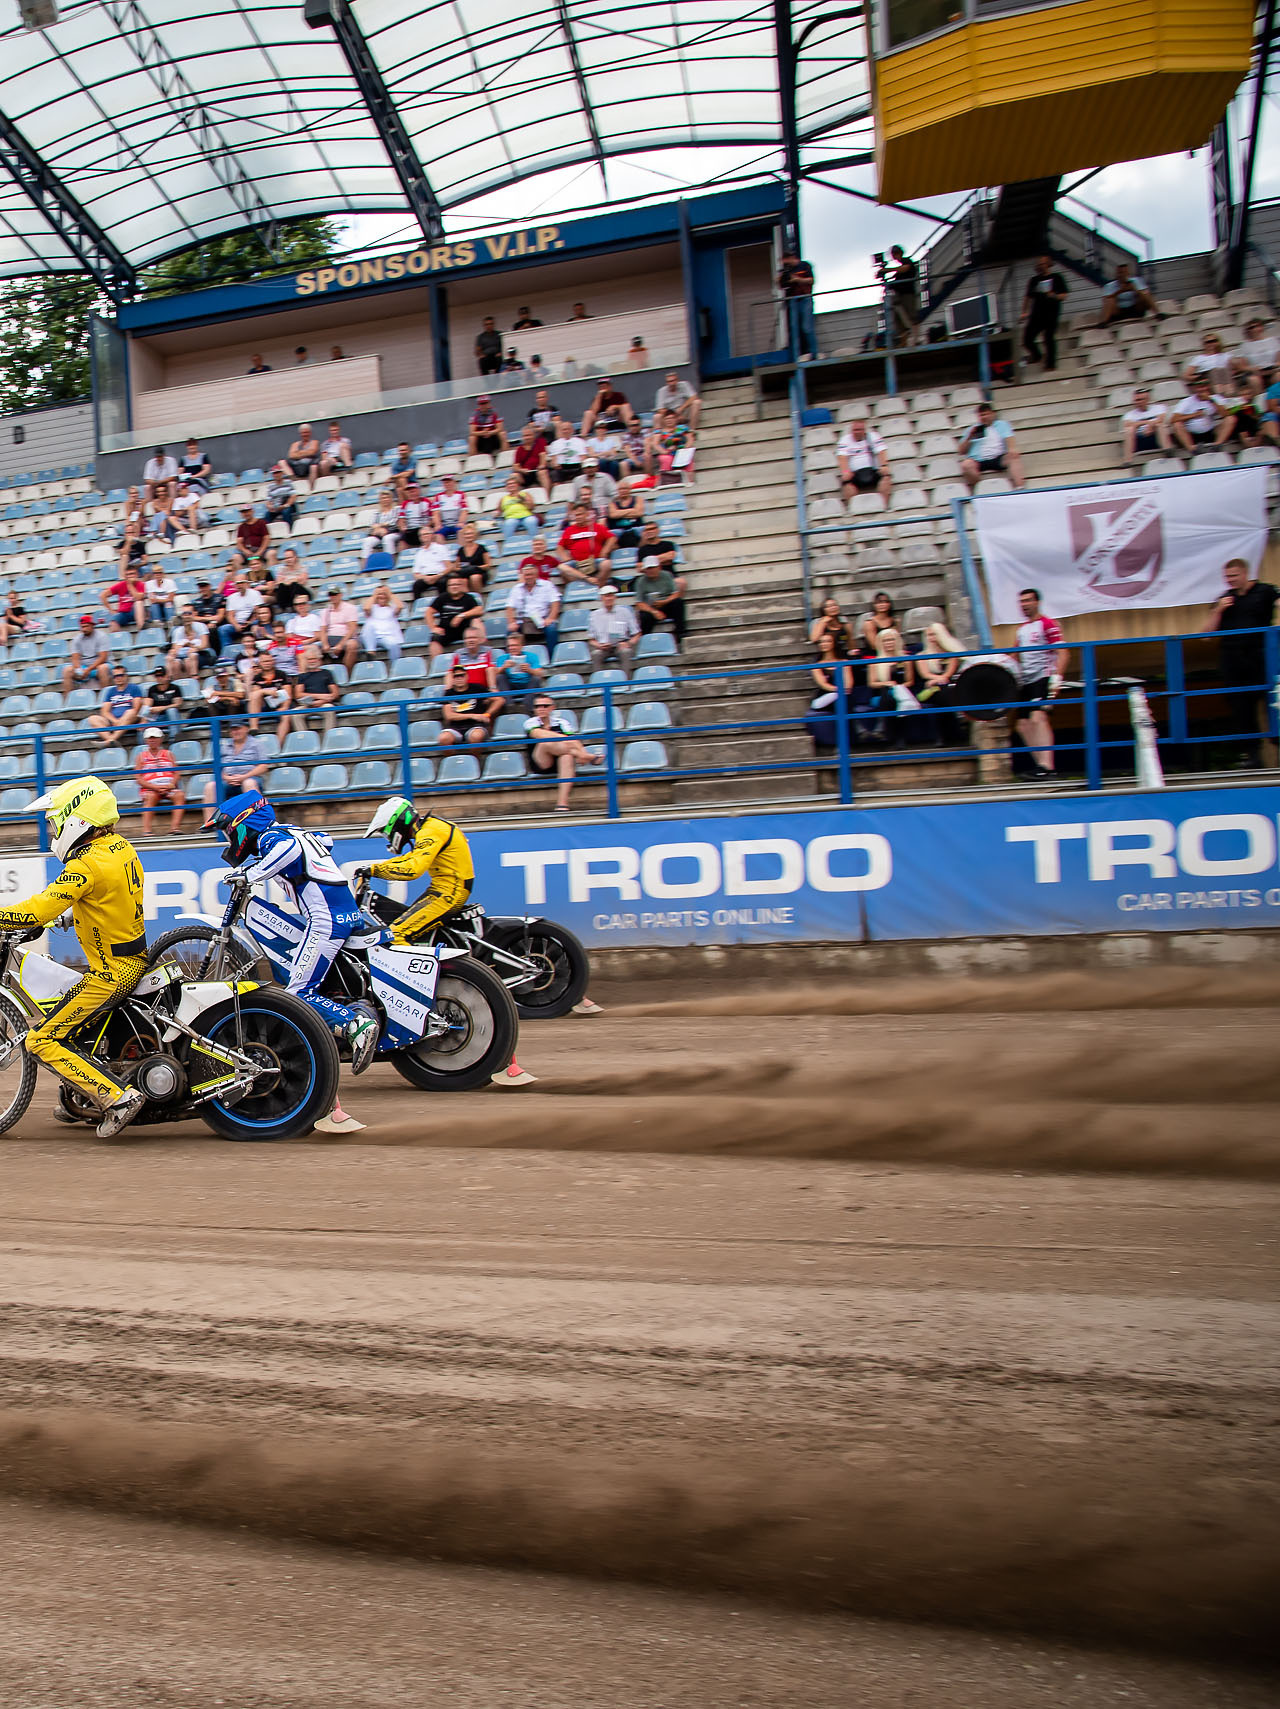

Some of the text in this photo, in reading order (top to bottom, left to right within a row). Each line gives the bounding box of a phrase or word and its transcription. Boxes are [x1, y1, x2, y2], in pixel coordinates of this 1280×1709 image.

[295, 227, 565, 295] SPONSORS V.I.P.
[1005, 813, 1280, 884] TRO
[59, 874, 81, 883] LOTTO
[500, 834, 893, 905] TRODO
[222, 900, 235, 924] SAGARI
[1117, 893, 1173, 912] CAR
[1175, 889, 1262, 910] PARTS
[257, 909, 294, 935] SAGARI
[336, 912, 361, 924] SAGA
[593, 907, 795, 931] CAR PARTS ONLINE
[296, 932, 320, 980] SAGARI
[408, 959, 434, 974] 30
[379, 991, 424, 1020] SAGARI
[59, 1057, 99, 1087] spechouse
